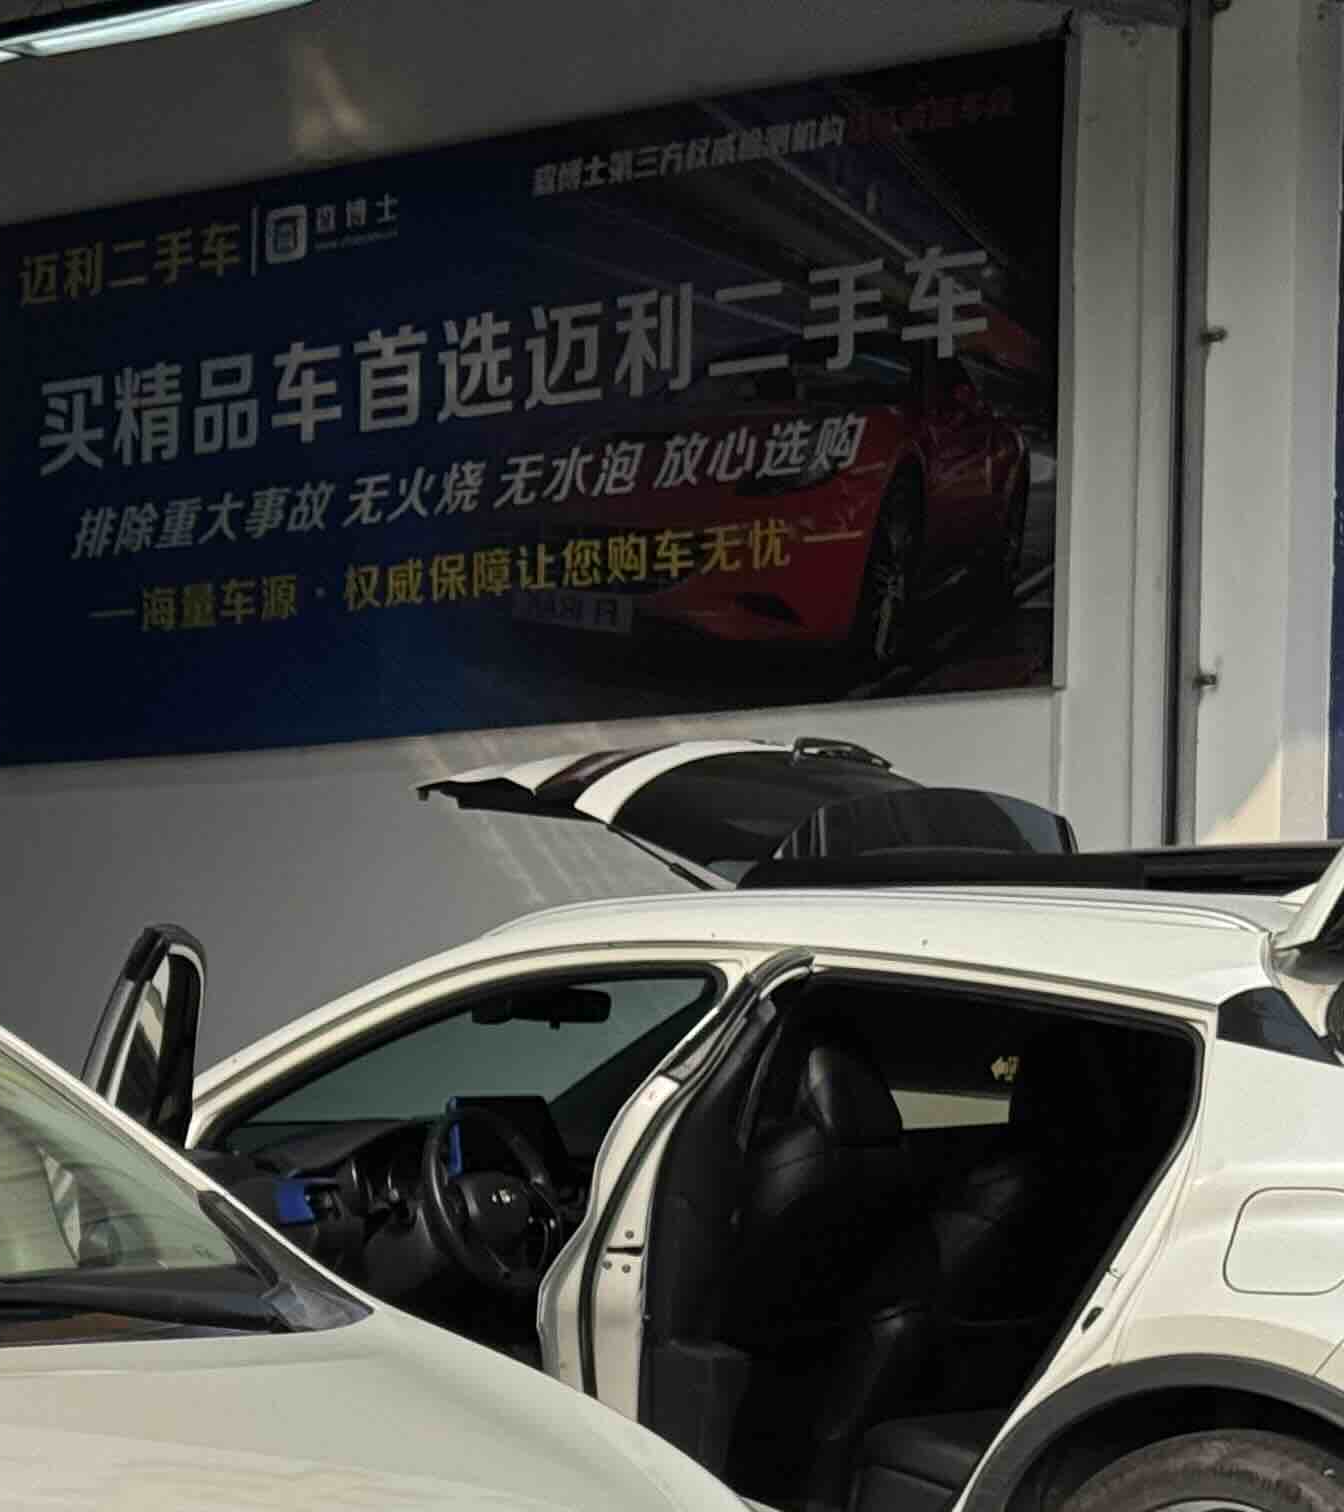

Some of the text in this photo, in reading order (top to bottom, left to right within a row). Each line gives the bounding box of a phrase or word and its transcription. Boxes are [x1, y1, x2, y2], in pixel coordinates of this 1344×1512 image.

[18, 221, 240, 307] 迈利二手车
[38, 247, 989, 476] 买精品车首选迈利二手车
[71, 412, 868, 560] 排除重大事故 无火烧 无水泡 放心选购
